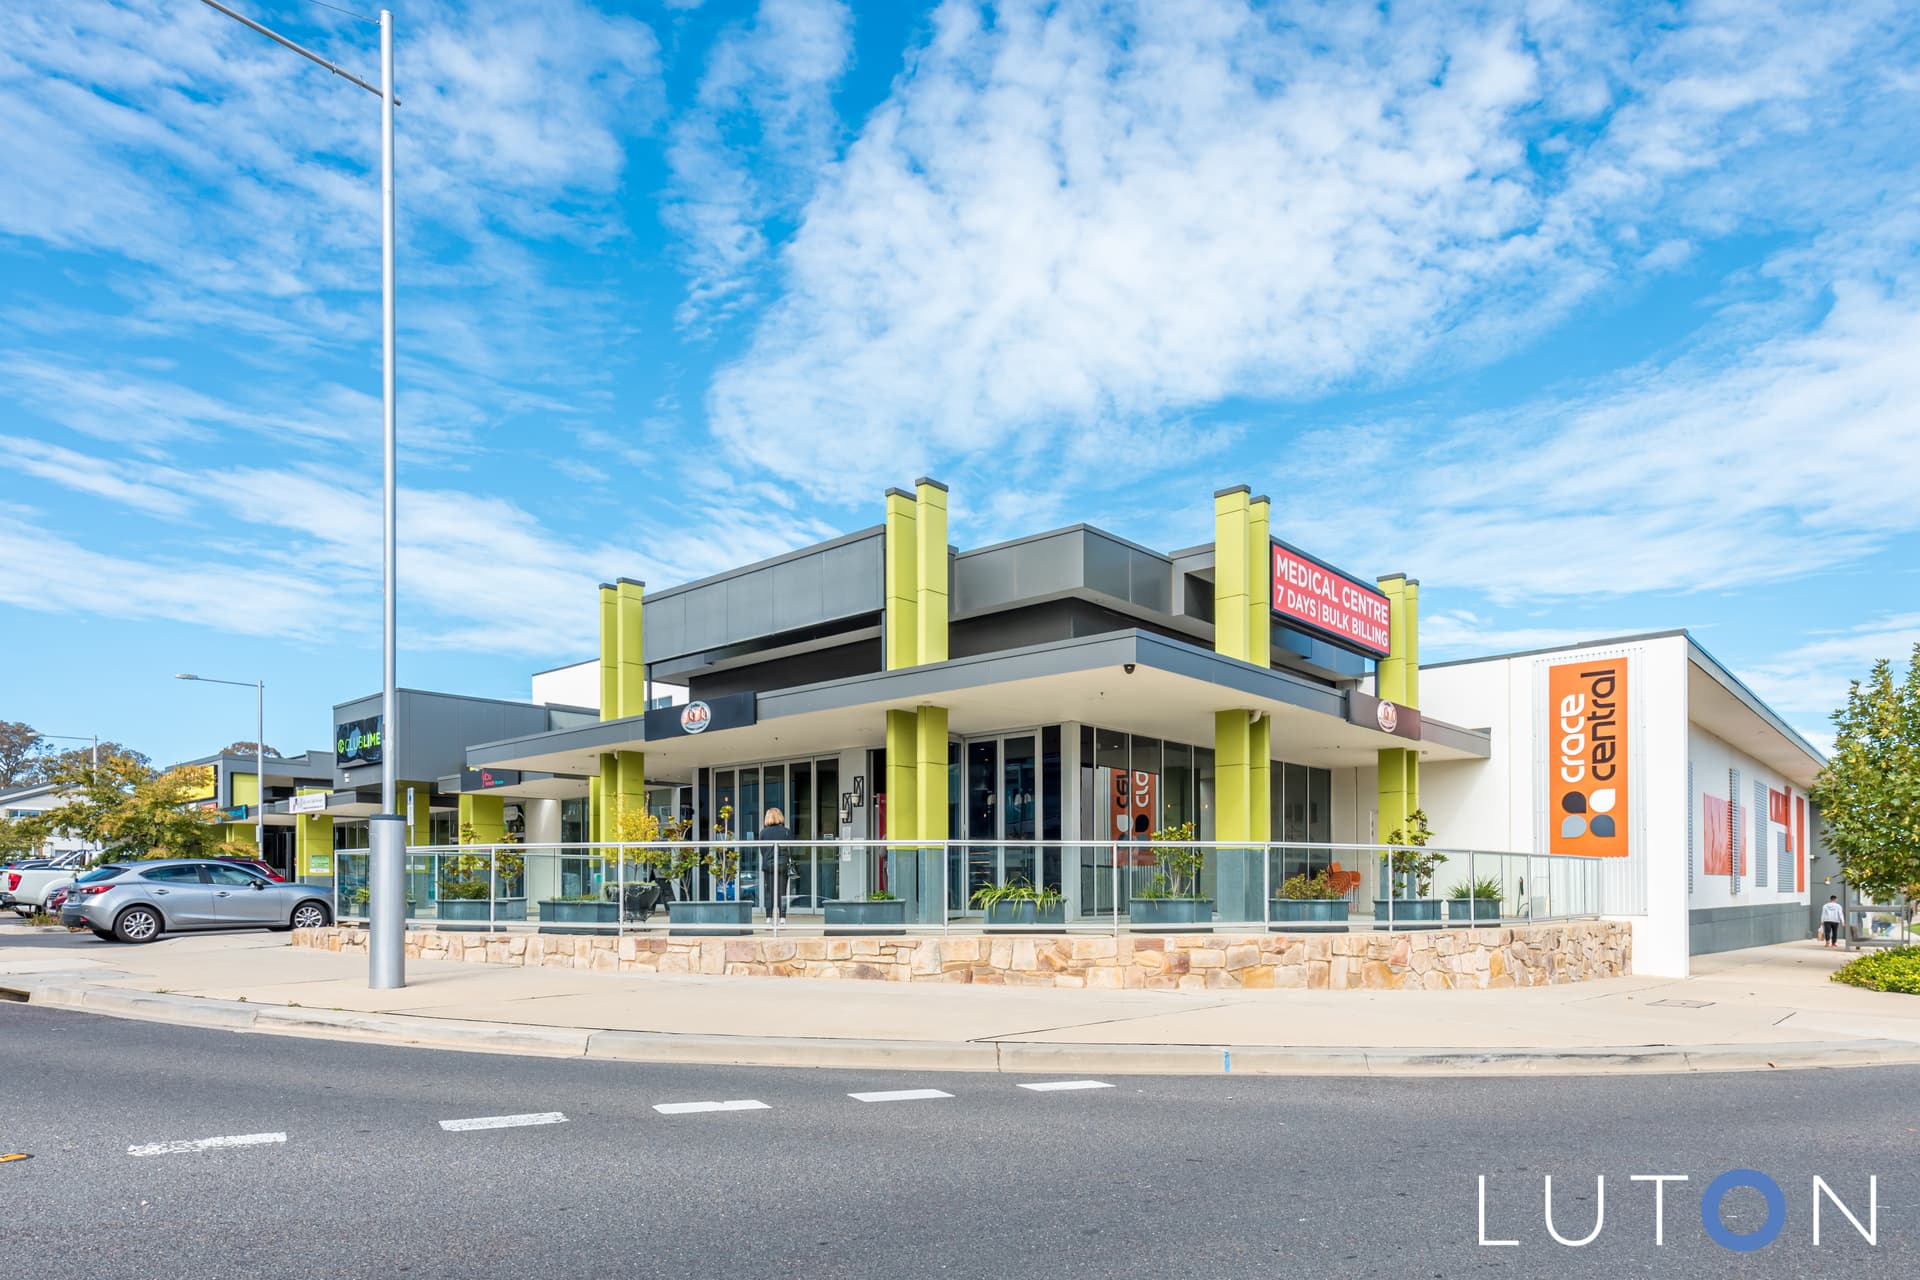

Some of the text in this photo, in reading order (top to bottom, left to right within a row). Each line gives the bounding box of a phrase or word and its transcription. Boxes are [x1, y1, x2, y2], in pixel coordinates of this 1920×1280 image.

[1276, 553, 1388, 625] MEDICAL CENTRE
[1276, 584, 1388, 647] 7 DAYS BULK BILLING
[1560, 693, 1585, 783] crace
[1580, 669, 1616, 781] central
